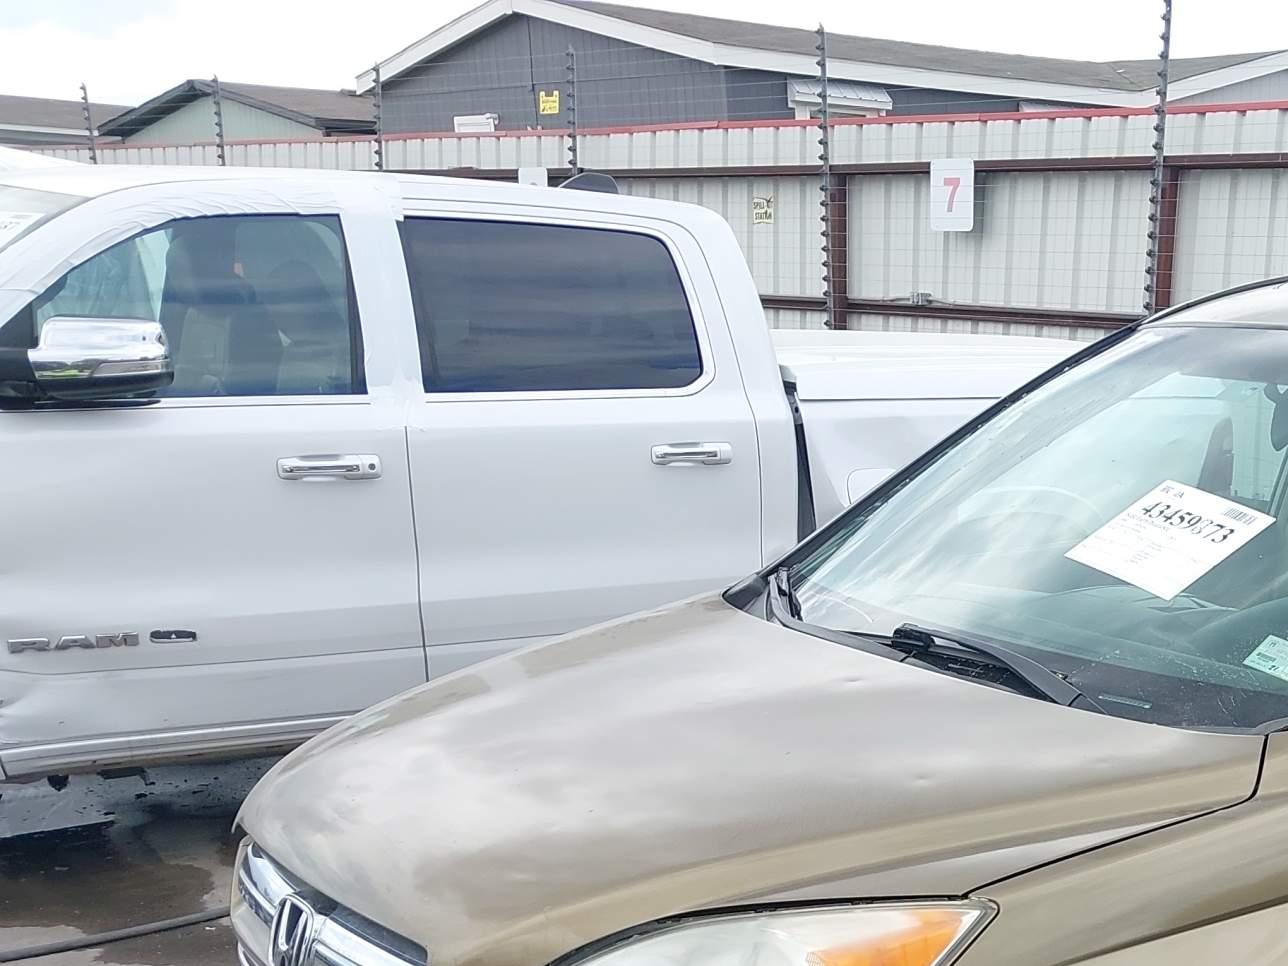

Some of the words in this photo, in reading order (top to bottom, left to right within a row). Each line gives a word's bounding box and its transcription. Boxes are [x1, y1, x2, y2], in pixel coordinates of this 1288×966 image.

[944, 177, 960, 212] 7
[1141, 501, 1235, 544] 43459873
[7, 632, 139, 653] RAM
